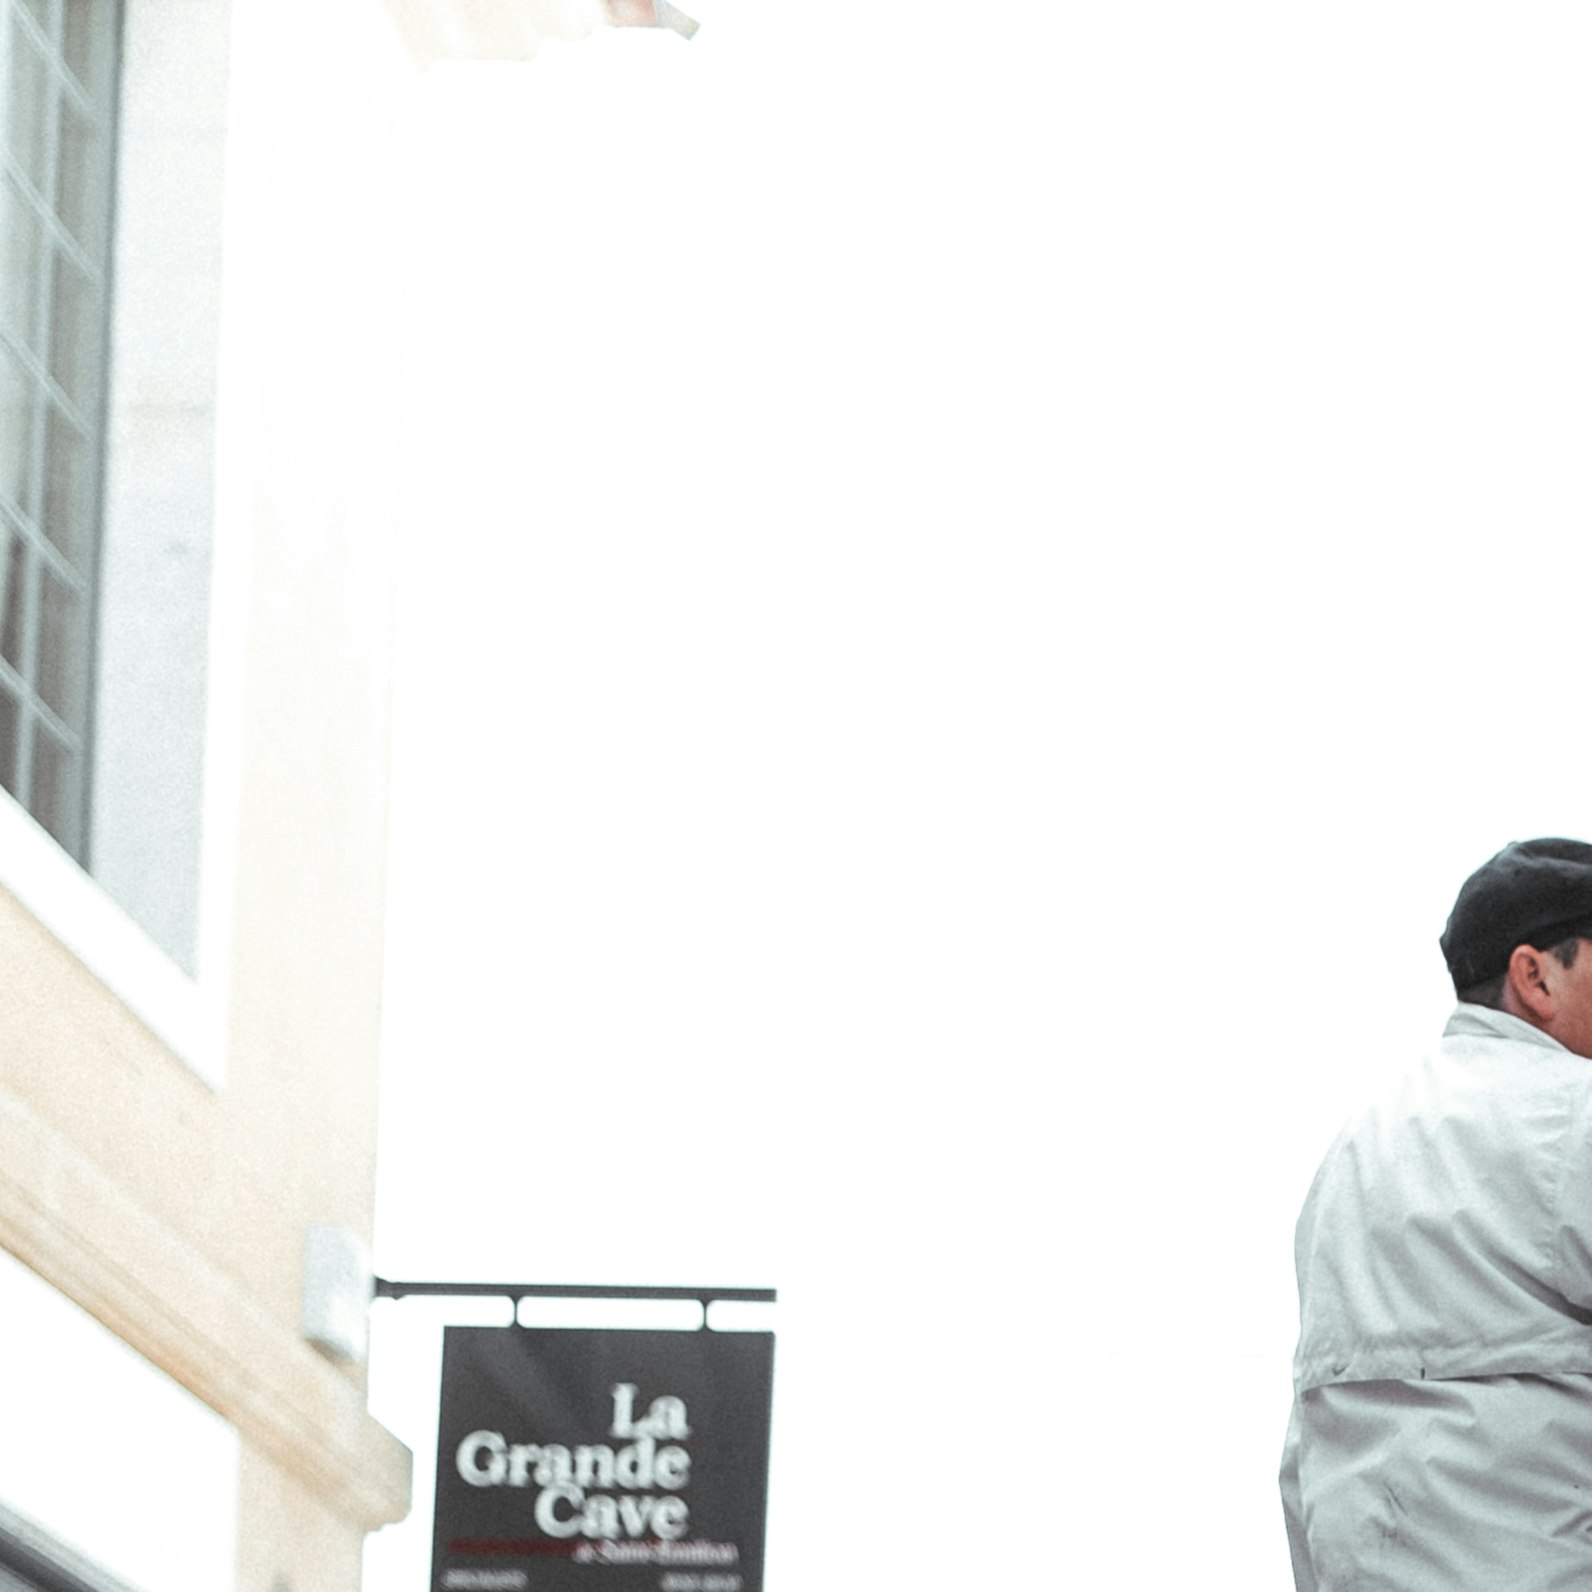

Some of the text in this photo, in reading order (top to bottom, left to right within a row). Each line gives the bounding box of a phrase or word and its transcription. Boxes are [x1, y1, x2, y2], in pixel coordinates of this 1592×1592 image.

[611, 1382, 691, 1440] La
[456, 1429, 692, 1490] Grande
[534, 1481, 690, 1540] Cave
